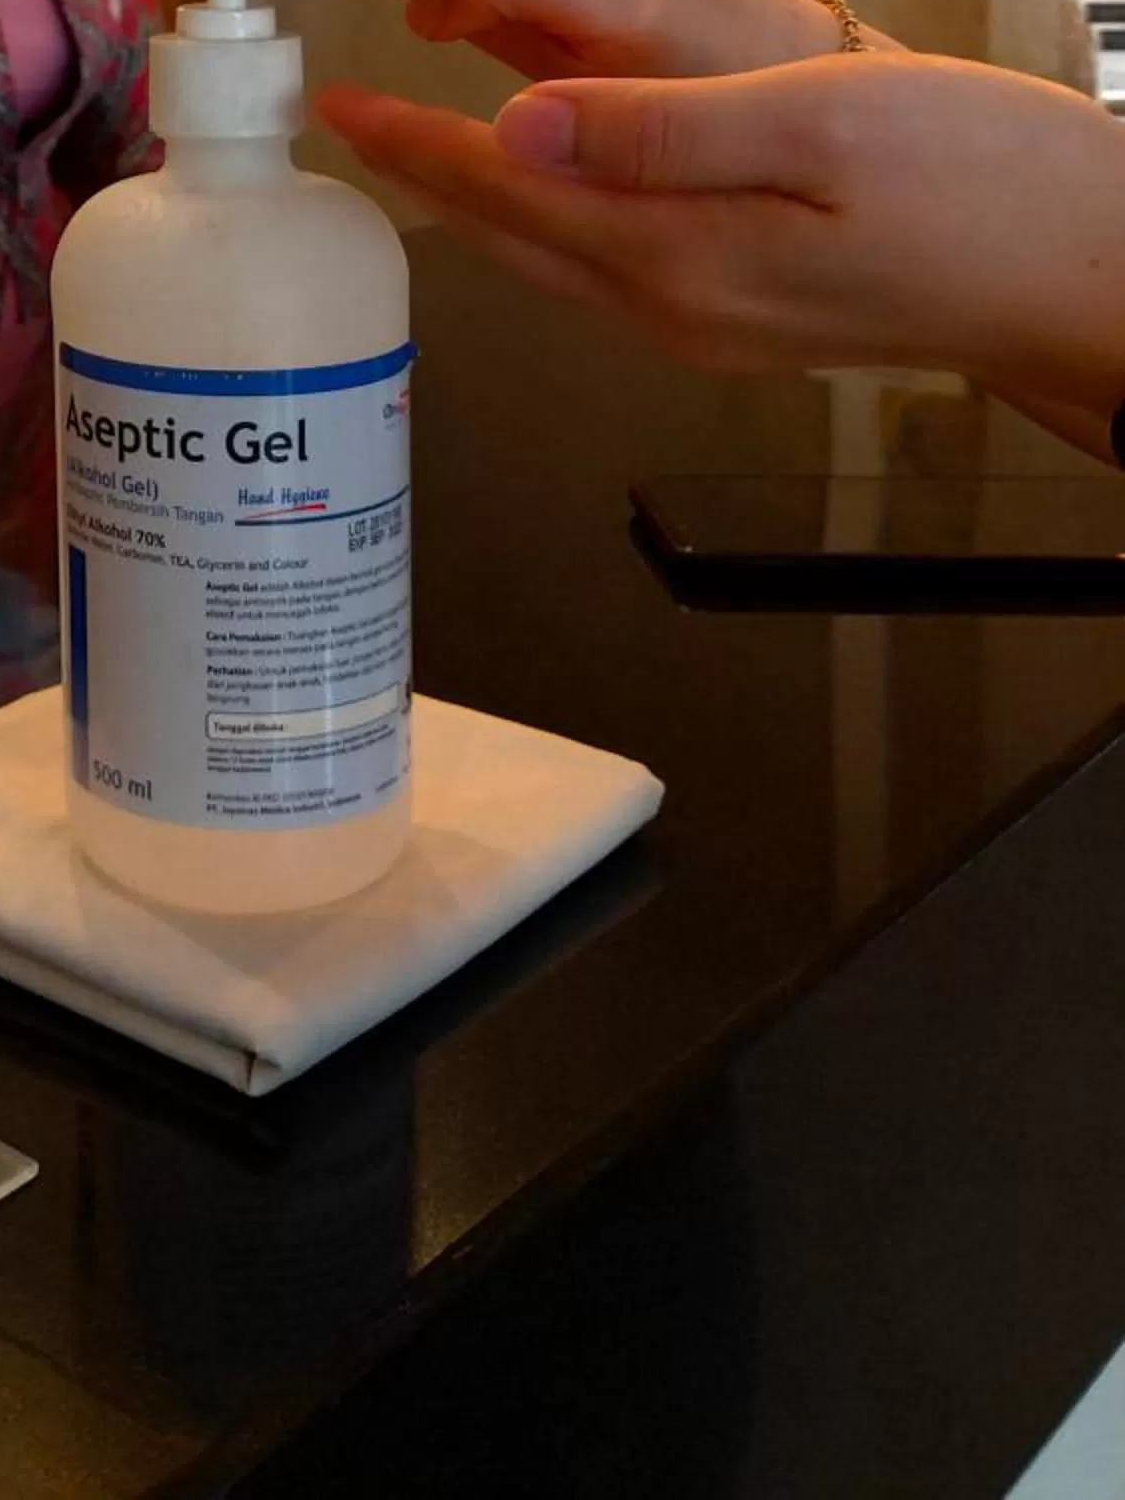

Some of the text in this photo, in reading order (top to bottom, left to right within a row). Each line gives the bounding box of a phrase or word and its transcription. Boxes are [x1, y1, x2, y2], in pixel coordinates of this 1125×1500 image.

[65, 393, 309, 465] Aseptic Gel
[122, 474, 159, 501] Gel)
[237, 487, 275, 506] Hand
[173, 505, 224, 527] Tangan
[135, 528, 168, 550] 70%
[248, 557, 270, 571] and
[93, 758, 153, 803] 500 ml
